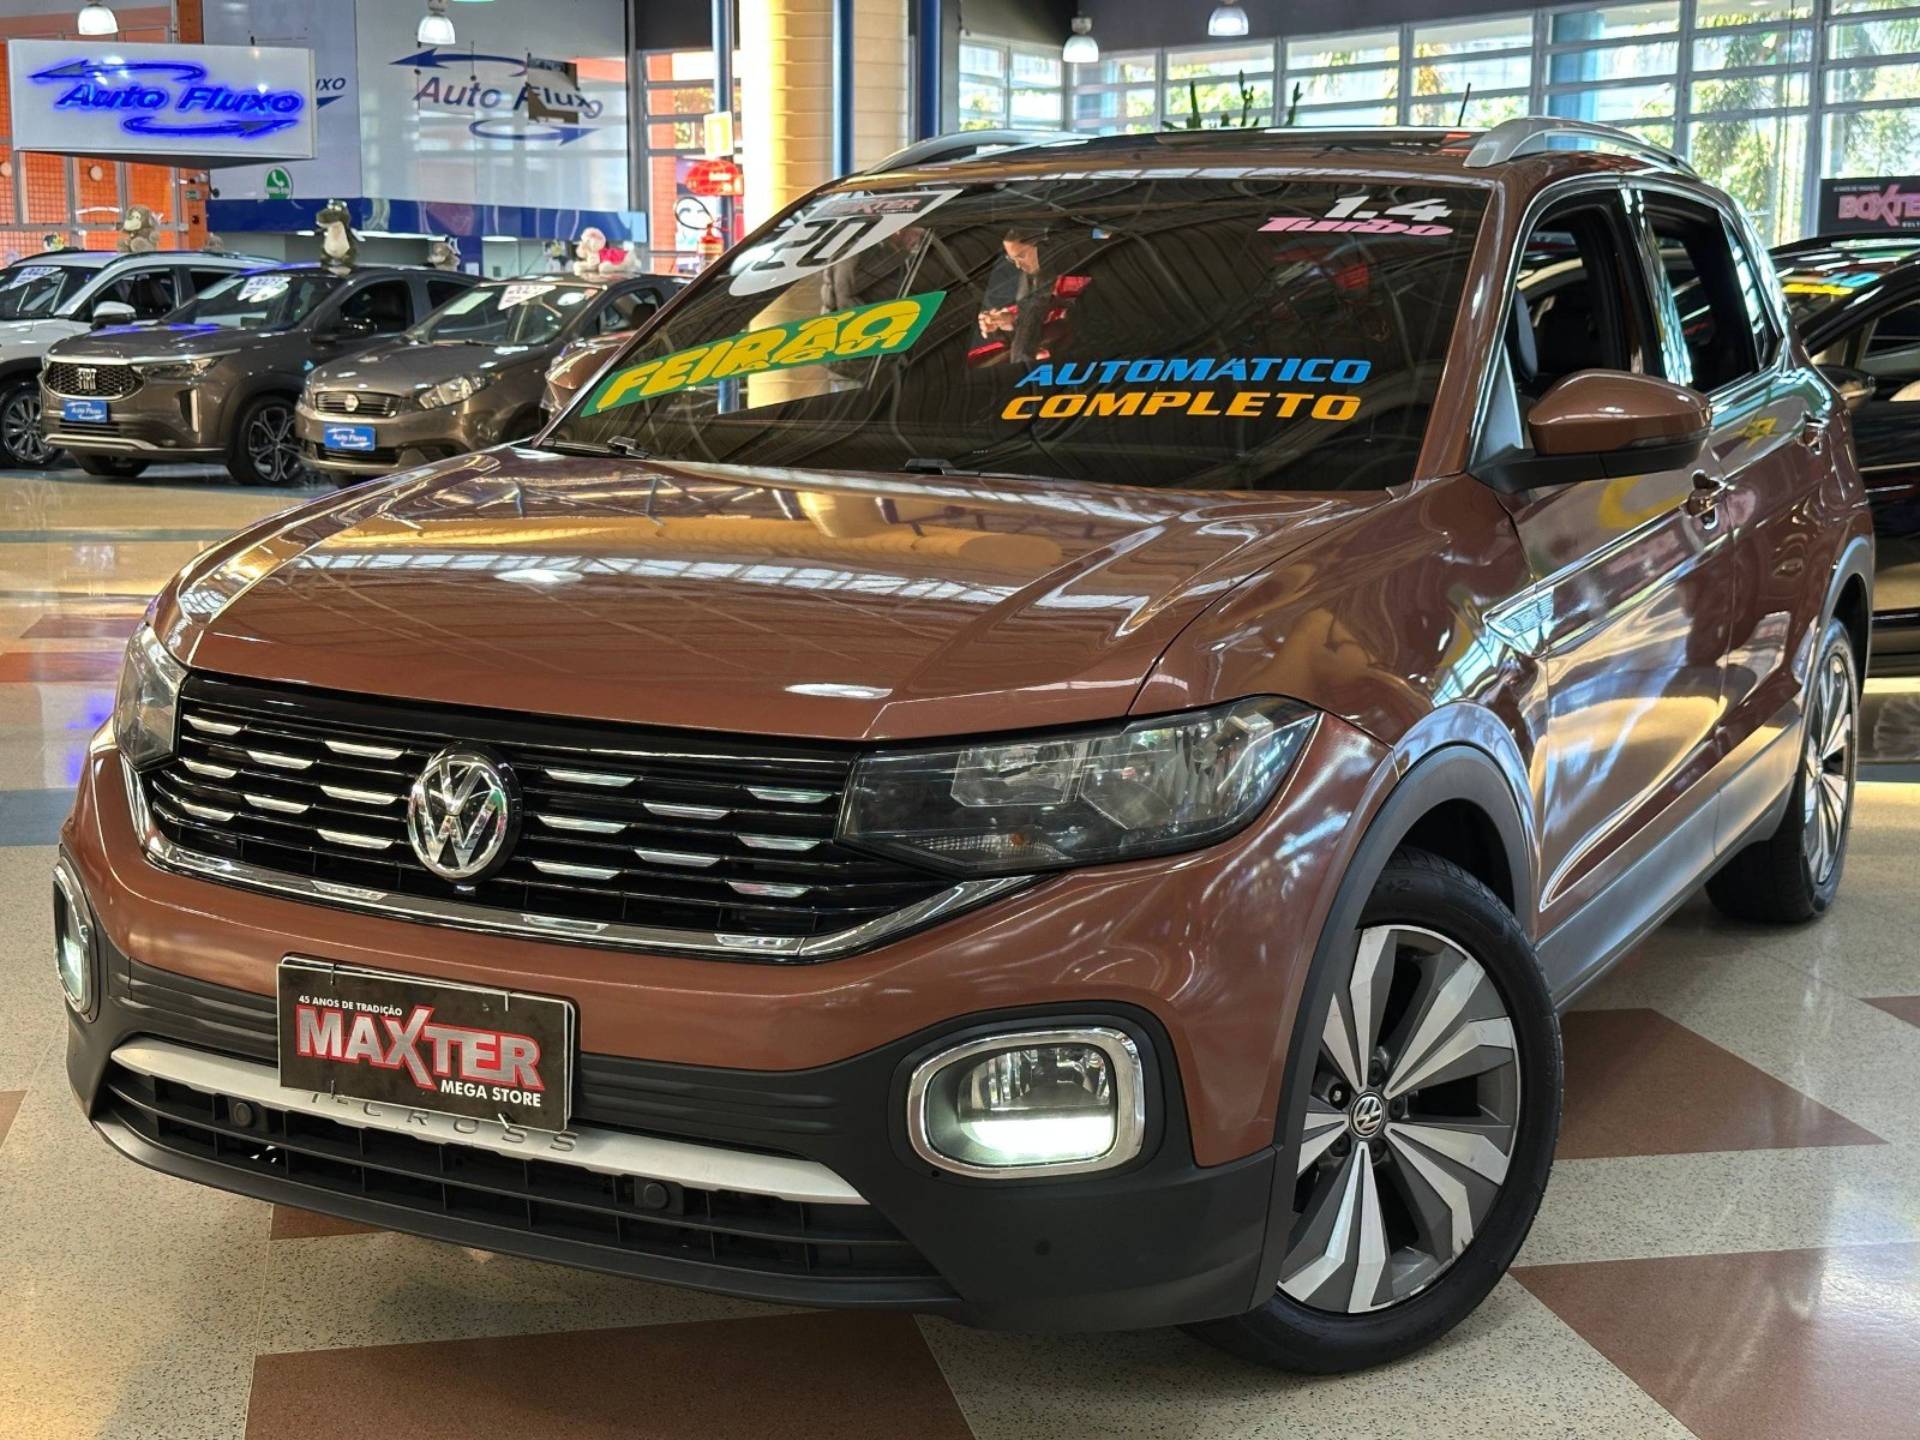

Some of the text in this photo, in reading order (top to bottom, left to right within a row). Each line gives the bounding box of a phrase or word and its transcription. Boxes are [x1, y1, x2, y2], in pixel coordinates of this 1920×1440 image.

[55, 82, 303, 114] Auto Fluxo
[412, 76, 501, 109] Auto
[1324, 196, 1452, 221] 1.4
[1000, 391, 1362, 421] COMPLETO
[299, 995, 403, 1017] 45 ANOS DE TRADIÇÃO
[296, 1005, 545, 1091] MAXTER
[440, 1079, 542, 1108] MEGA STORE
